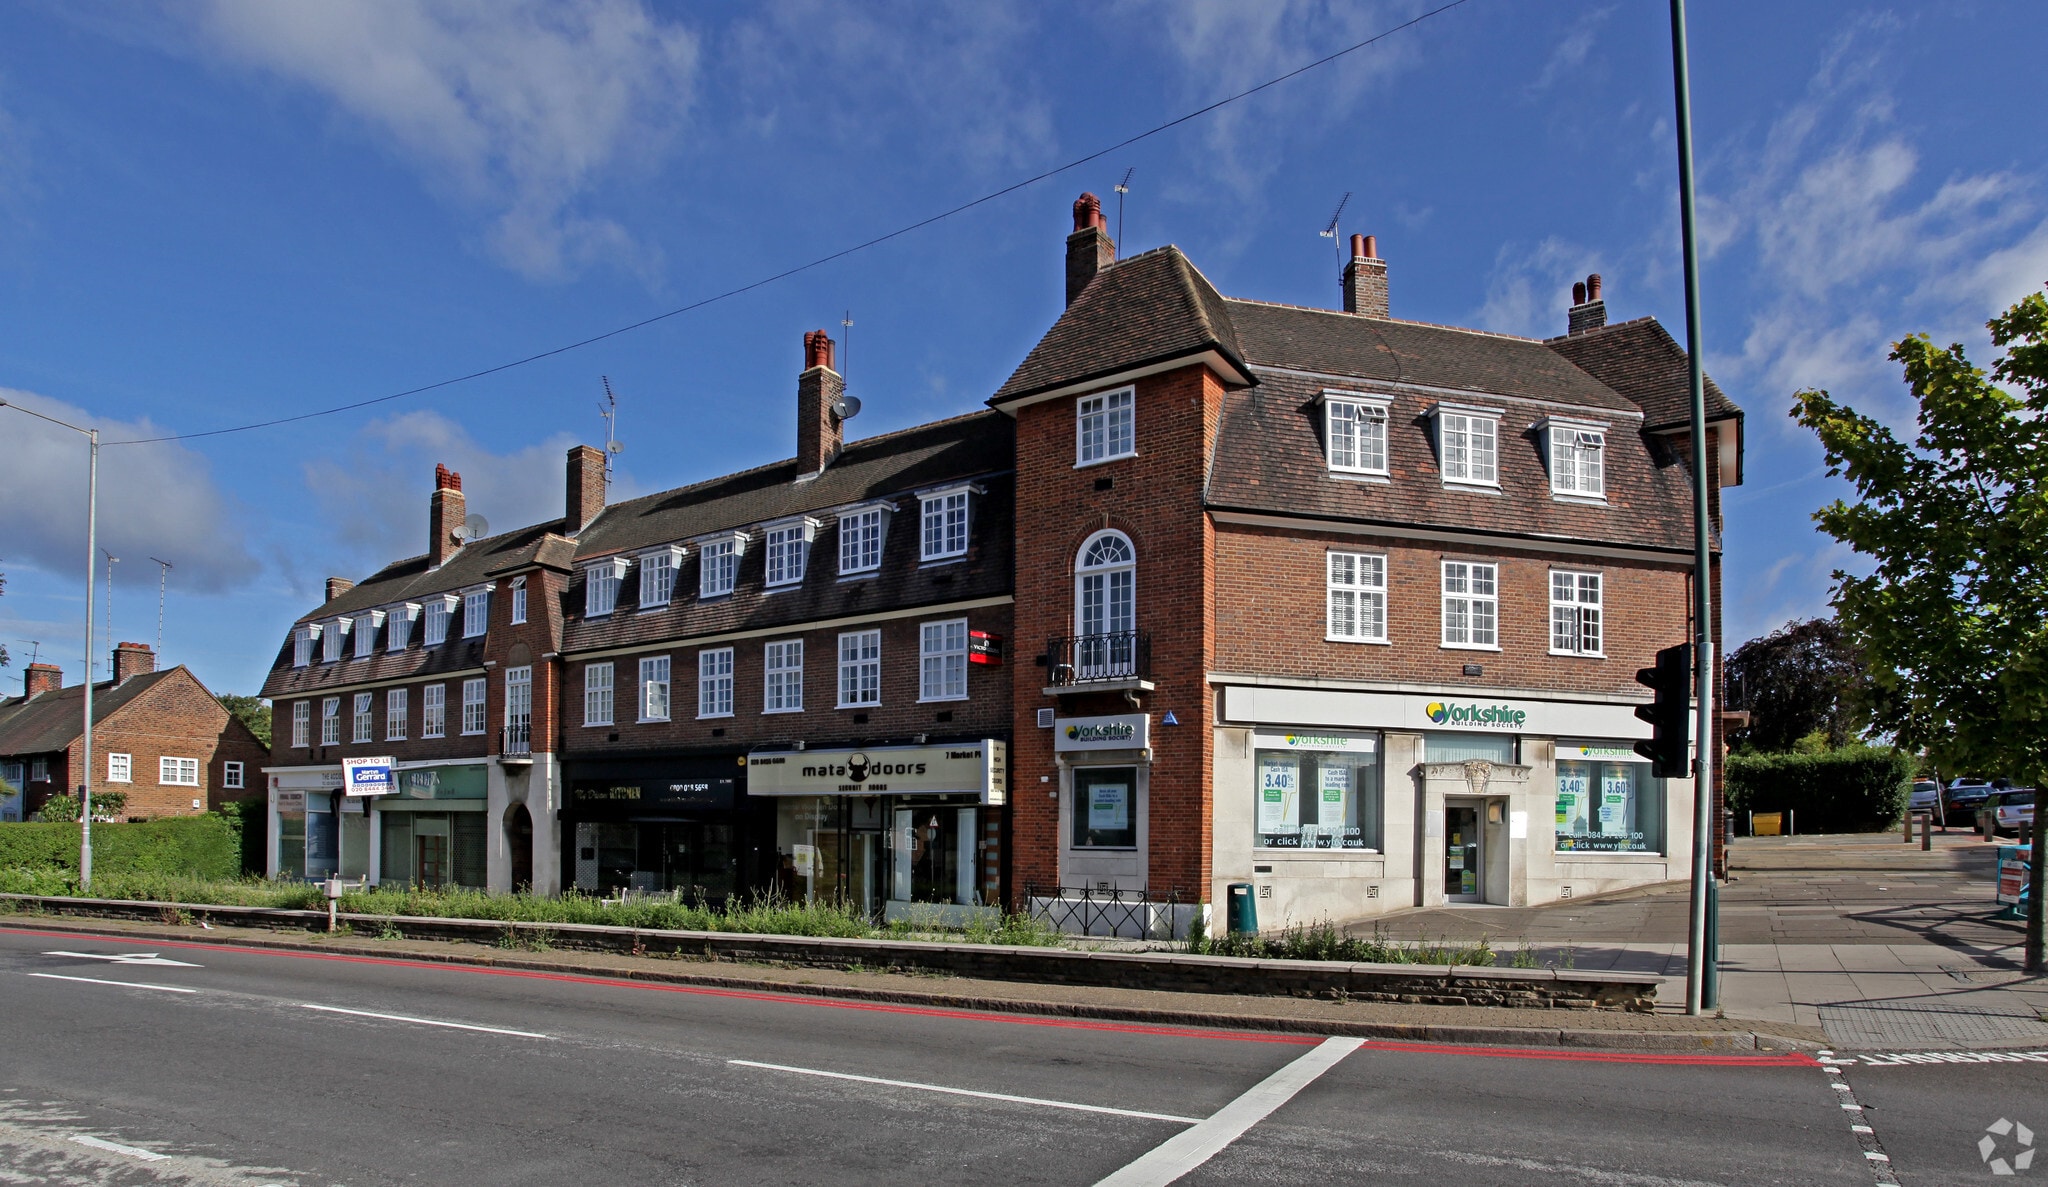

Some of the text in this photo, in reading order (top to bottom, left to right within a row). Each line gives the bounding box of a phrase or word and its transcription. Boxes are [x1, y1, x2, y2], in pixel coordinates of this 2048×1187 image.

[1439, 702, 1526, 725] Yorkshire
[1074, 722, 1134, 741] Yorkshire
[1294, 733, 1347, 746] Yorkshire
[1587, 745, 1633, 757] Yorkshire
[803, 762, 927, 777] mata doors
[356, 773, 386, 781] Gerrard
[1277, 837, 1298, 846] click
[1631, 832, 1644, 840] 100
